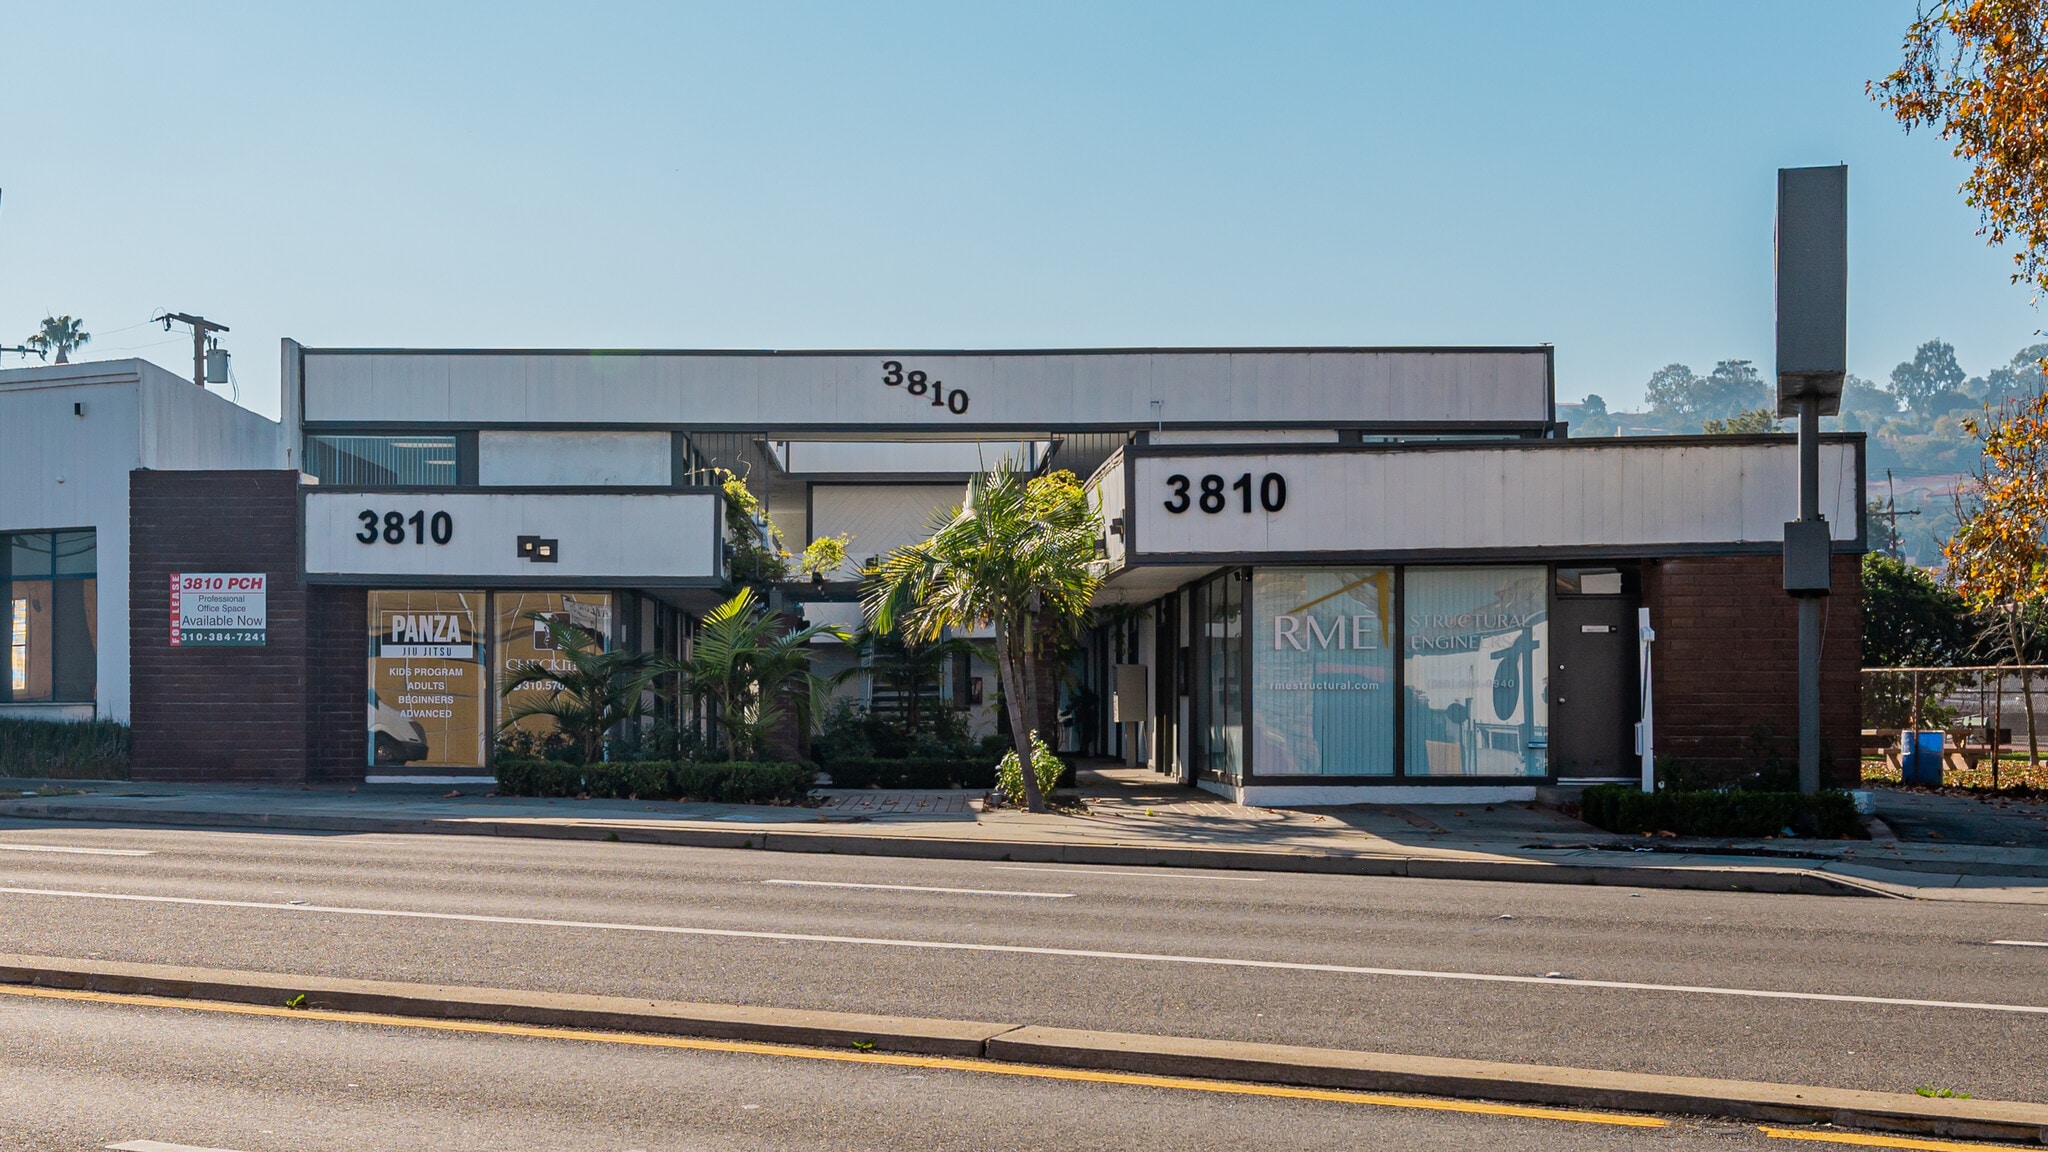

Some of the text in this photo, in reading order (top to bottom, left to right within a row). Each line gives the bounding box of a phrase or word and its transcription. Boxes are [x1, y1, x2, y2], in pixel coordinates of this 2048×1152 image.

[882, 360, 969, 415] 3810
[1163, 472, 1287, 514] 3810
[356, 509, 453, 545] 3810
[183, 577, 263, 590] 3810 PCH
[198, 595, 245, 603] Professional
[172, 575, 180, 644] FOR LEASE
[197, 605, 246, 614] Office Space
[182, 615, 263, 626] Available Now
[1410, 614, 1531, 628] STRUCTURAL
[392, 614, 462, 643] PANZA
[1273, 615, 1378, 651] RME
[180, 632, 266, 642] 310-384-7241
[1411, 635, 1514, 649] ENGINEERS
[402, 646, 452, 657] JIU JITSU
[389, 667, 463, 677] KIDS PROGRAM
[407, 681, 445, 690] ADULTS
[1269, 680, 1379, 691] rmestructural.com
[398, 695, 454, 704] BEGINNERS
[399, 709, 452, 718] ADVANCED
